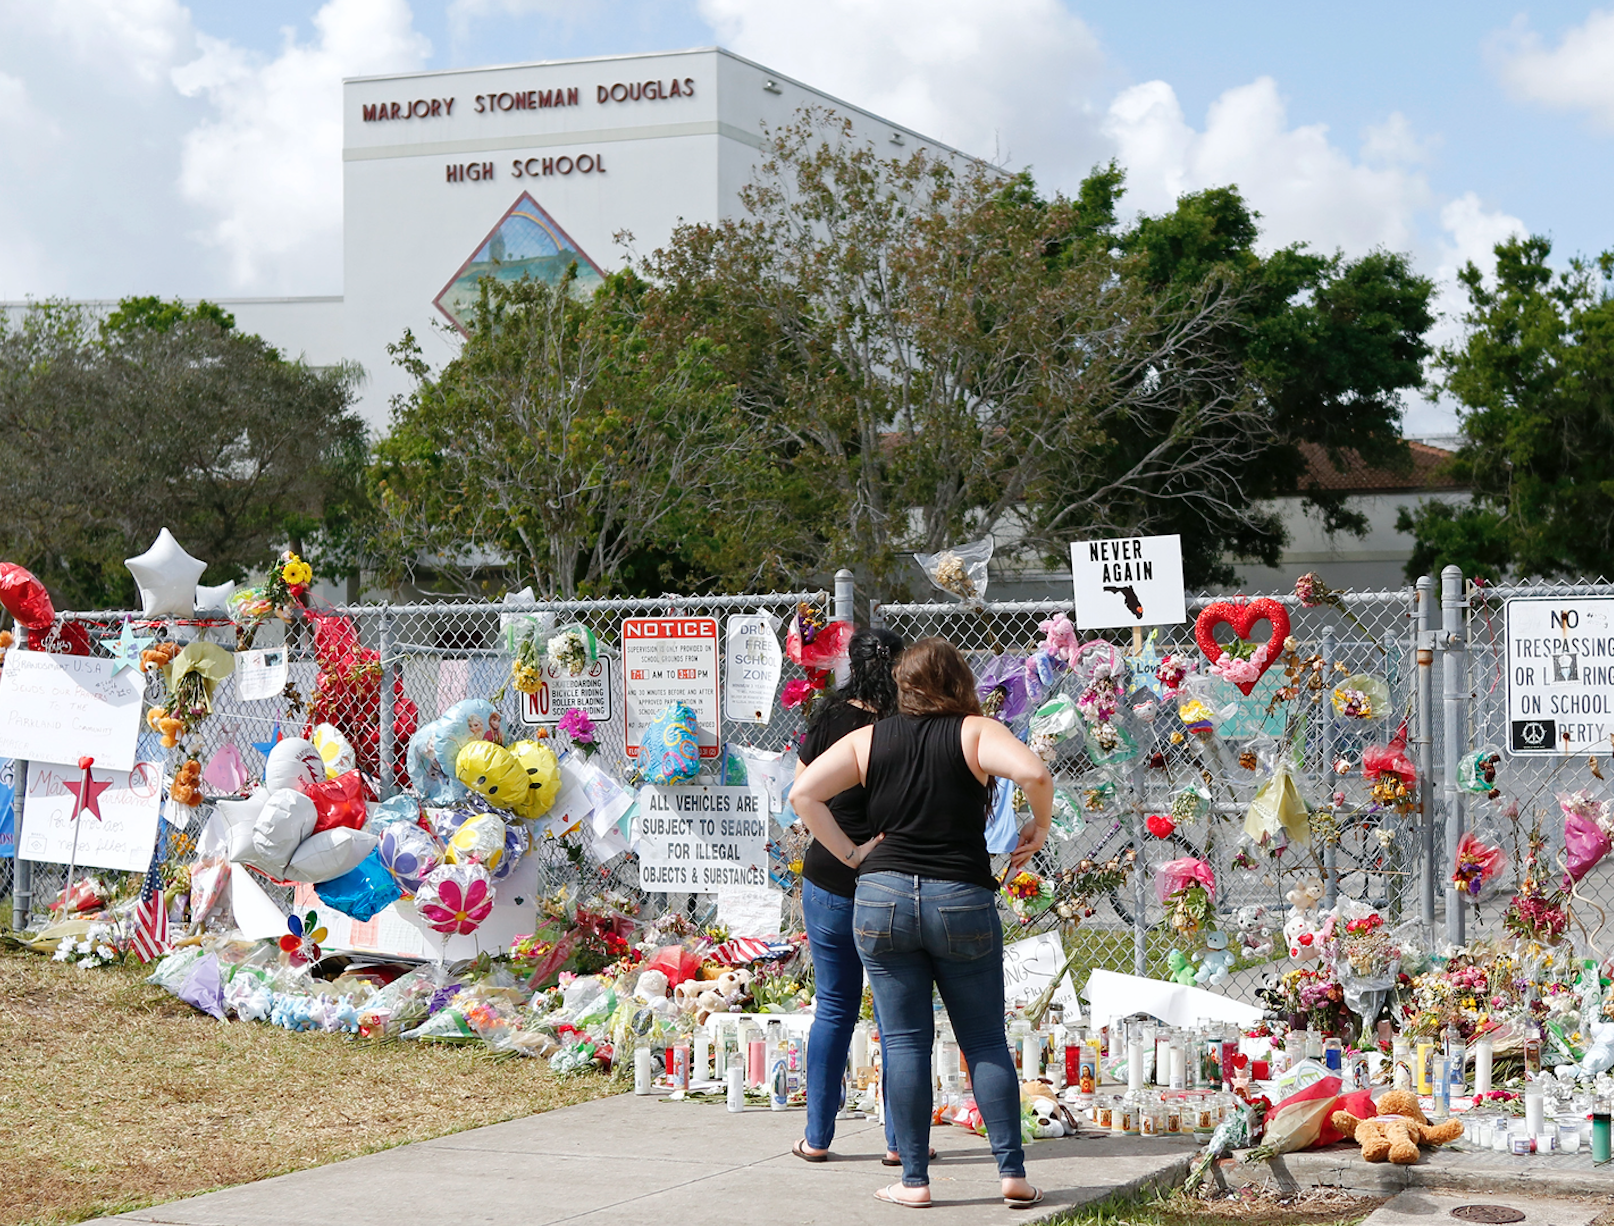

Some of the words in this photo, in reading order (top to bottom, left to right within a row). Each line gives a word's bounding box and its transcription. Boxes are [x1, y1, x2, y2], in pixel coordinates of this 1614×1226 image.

[363, 97, 454, 122] MARJORY
[474, 87, 579, 114] STONEMAN
[596, 78, 694, 104] DOUGLAS
[446, 162, 493, 183] HIGH
[511, 153, 606, 178] SCHOOL
[1090, 539, 1142, 562] NEVER
[1103, 561, 1153, 583] AGAIN
[1551, 610, 1579, 629] NO
[627, 622, 713, 637] NOTICE
[740, 624, 772, 636] DRUG
[627, 645, 657, 653] SUPERVISION
[745, 639, 773, 651] FREE
[1515, 637, 1614, 658] TRESPASSING
[735, 654, 777, 667] SCHOOL
[652, 670, 663, 679] AM
[667, 670, 675, 679] TO
[697, 670, 708, 678] PM
[743, 669, 772, 681] ZONE
[1515, 667, 1534, 686] OR
[1544, 666, 1614, 686] LRING
[552, 679, 602, 688] SKATEBOARDING
[529, 681, 549, 716] NO
[552, 689, 579, 698] BICYCLE
[581, 688, 604, 697] RIDING
[69, 702, 88, 712] THE
[552, 699, 576, 707] ROLLER
[577, 697, 605, 706] BLADING
[1521, 695, 1541, 714] ON
[1551, 694, 1611, 714] SCHOOL
[1558, 723, 1605, 742] PERTY
[650, 795, 669, 811] ALL
[676, 795, 730, 812] VEHICLES
[736, 796, 759, 812] ARE
[642, 818, 693, 835] SUBJECT
[699, 819, 715, 836] TO
[721, 819, 765, 837] SEARCH
[668, 843, 690, 860] FOR
[696, 843, 740, 860] ILLEGAL
[643, 866, 687, 884] OBJECTS
[692, 867, 699, 884] &
[703, 867, 765, 885] SUBSTANCES
